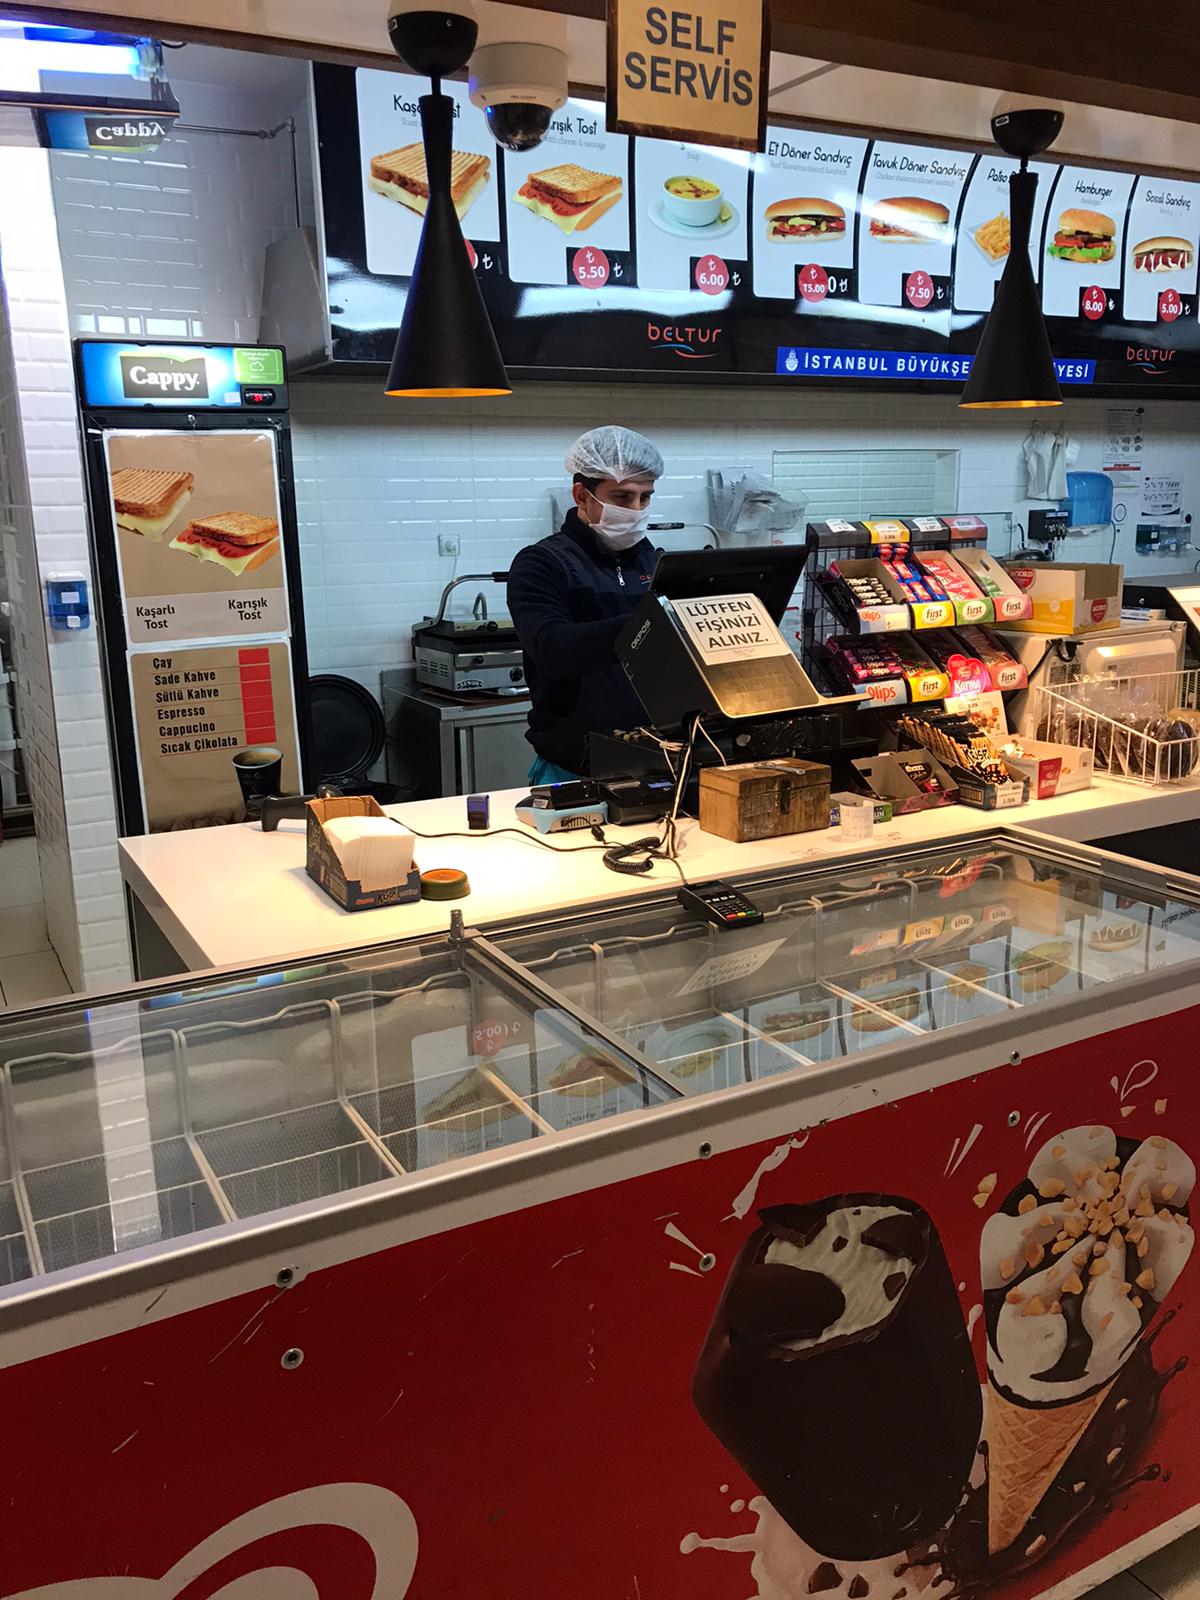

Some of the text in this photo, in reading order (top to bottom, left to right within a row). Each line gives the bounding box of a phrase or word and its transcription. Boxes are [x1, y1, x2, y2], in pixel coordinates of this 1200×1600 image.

[646, 7, 737, 55] SELF
[624, 51, 753, 106] SERVİS
[576, 118, 598, 136] Tost
[768, 140, 780, 157] Et
[780, 142, 812, 161] Döner
[813, 146, 853, 169] Sandviç
[872, 153, 898, 170] Tavuk
[899, 156, 929, 174] Döner
[929, 160, 967, 182] Sandviç
[1074, 180, 1113, 201] Hamburger
[1165, 193, 1191, 212] Sandviç
[578, 265, 606, 281] 5.50
[699, 272, 724, 287] 6.00
[802, 283, 826, 294] 15.00
[909, 286, 930, 299] 7.50
[1085, 300, 1103, 313] 8.00
[1161, 302, 1178, 315] 5.00
[804, 351, 1089, 378] İSTANBUL BÜYÜKŞE YESİ
[136, 604, 176, 619] Kaşarlı
[228, 597, 268, 611] Karışık
[685, 600, 753, 618] LÜTFEN
[966, 605, 982, 616] first
[1006, 602, 1021, 612] first
[238, 610, 262, 621] Tost
[926, 608, 942, 619] first
[144, 619, 169, 630] Tost
[695, 613, 762, 634] FİŞİNİZİ
[630, 619, 652, 650] OKPOS
[708, 631, 769, 649] ALINIZ.
[152, 657, 173, 670] Çay
[154, 670, 216, 686] Sade Kahve
[1002, 672, 1016, 682] first
[922, 680, 939, 692] first
[156, 686, 220, 704] Sütlü Kahve
[157, 705, 206, 721] Espresso
[159, 721, 216, 738] Cappucino
[161, 735, 239, 755] Sıcak Çikolata
